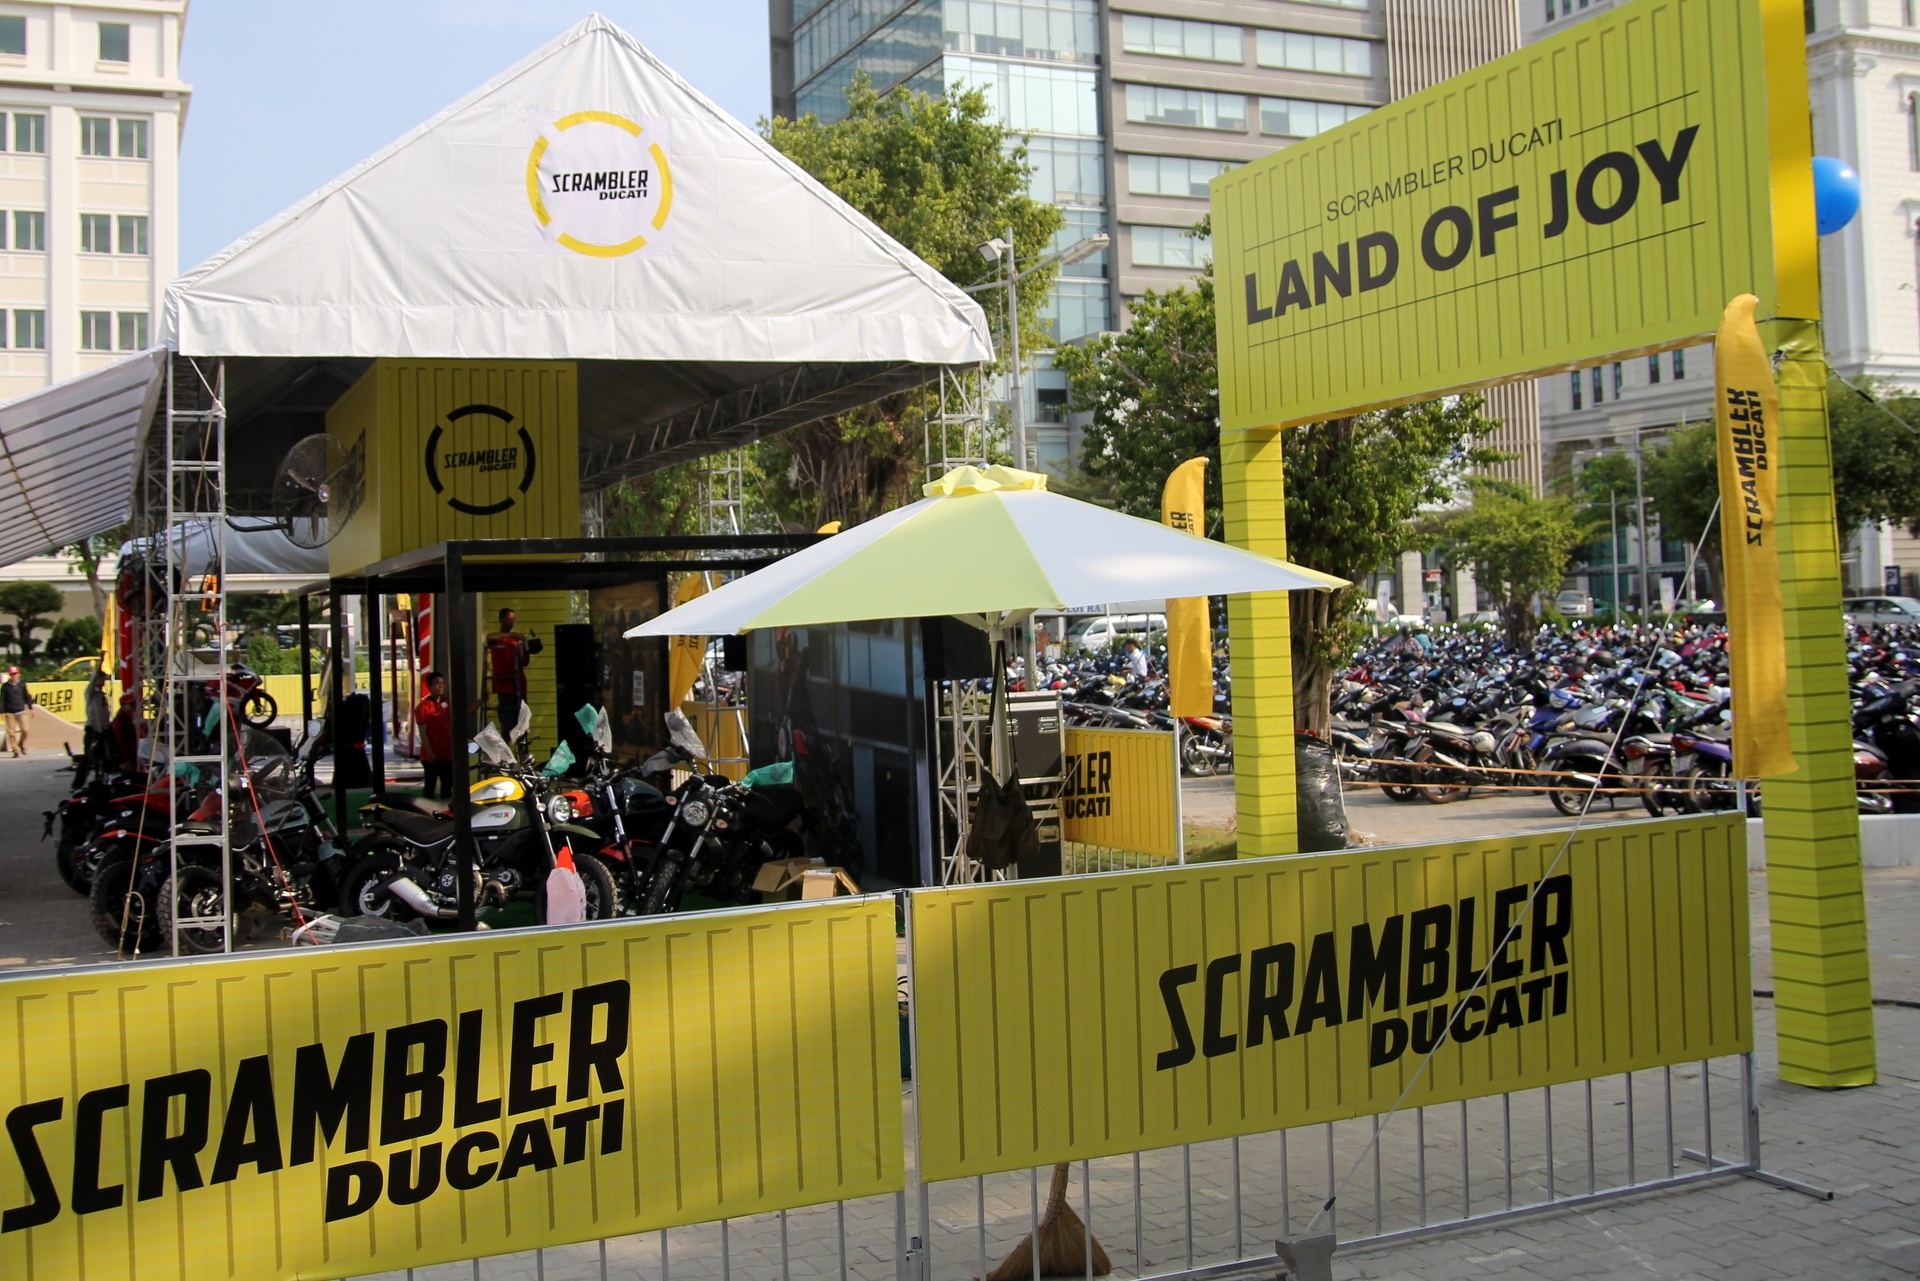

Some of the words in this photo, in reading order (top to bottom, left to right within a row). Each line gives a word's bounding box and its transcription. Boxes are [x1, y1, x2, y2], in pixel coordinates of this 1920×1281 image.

[552, 169, 648, 193] SCRAMBLER
[599, 189, 648, 201] DUCATI
[1326, 156, 1464, 222] SCRAMBLER
[1471, 118, 1564, 170] DUCATI
[1245, 231, 1399, 325] LAND
[1421, 185, 1520, 271] OF
[1544, 124, 1700, 239] JOY
[444, 447, 517, 469] SCRAMBLER
[479, 462, 516, 473] DUCATI
[1726, 386, 1764, 547] SCRAMBLER
[1745, 390, 1768, 470] DUCATI
[1156, 874, 1572, 1072] SCRAMBLER
[1369, 971, 1569, 1068] DUCATI
[0, 979, 631, 1234] SCRAMBLER
[325, 1098, 625, 1223] DUCATI
